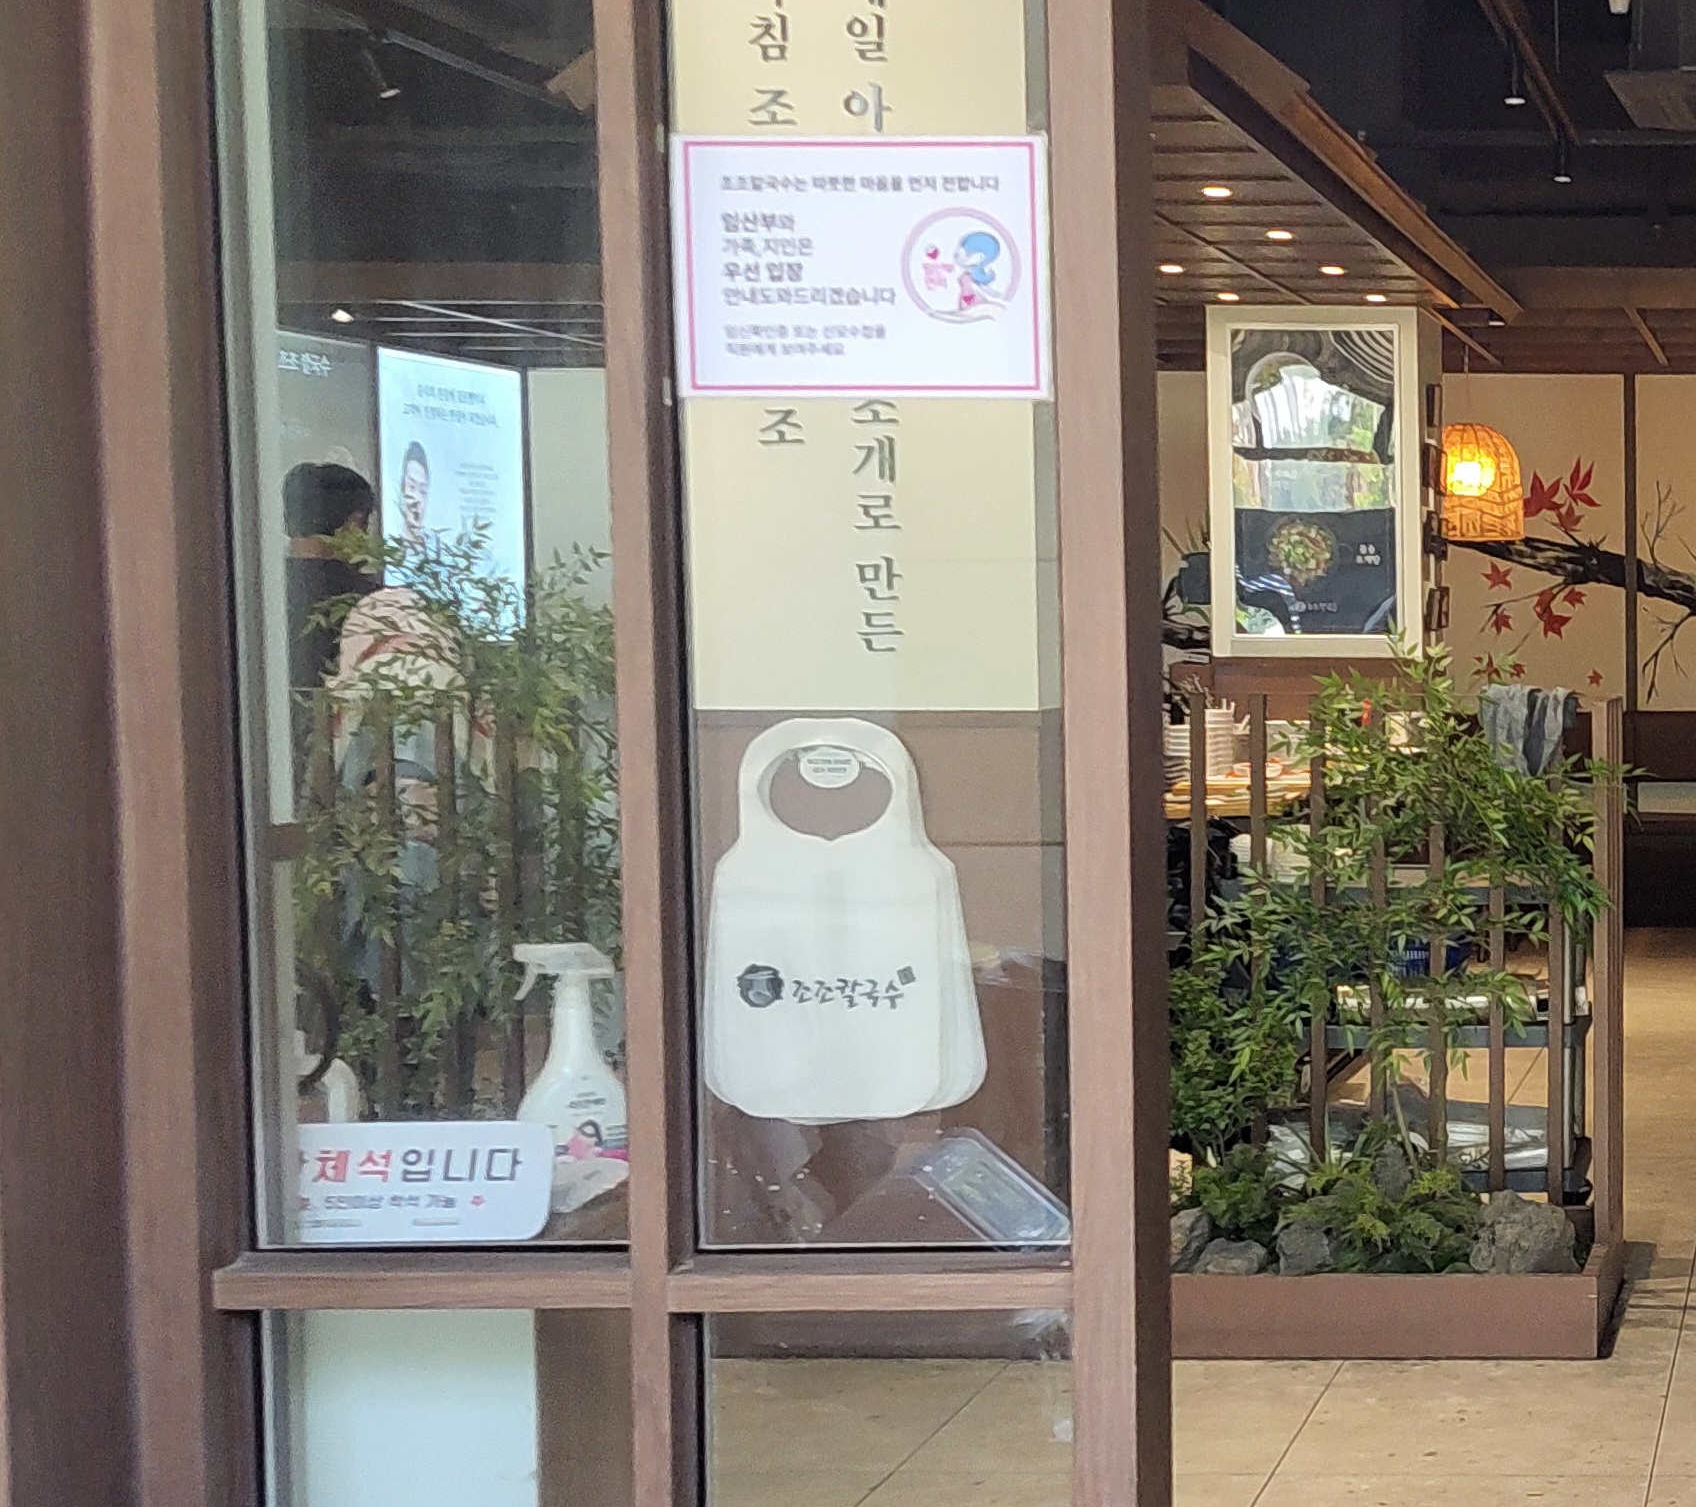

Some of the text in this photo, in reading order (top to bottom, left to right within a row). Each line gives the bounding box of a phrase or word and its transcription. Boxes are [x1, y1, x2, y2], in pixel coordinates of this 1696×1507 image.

[724, 261, 803, 282] 우선 입장
[855, 555, 905, 653] 만든
[791, 978, 904, 1011] 조조칼국수
[300, 1148, 523, 1183] 체석입니다
